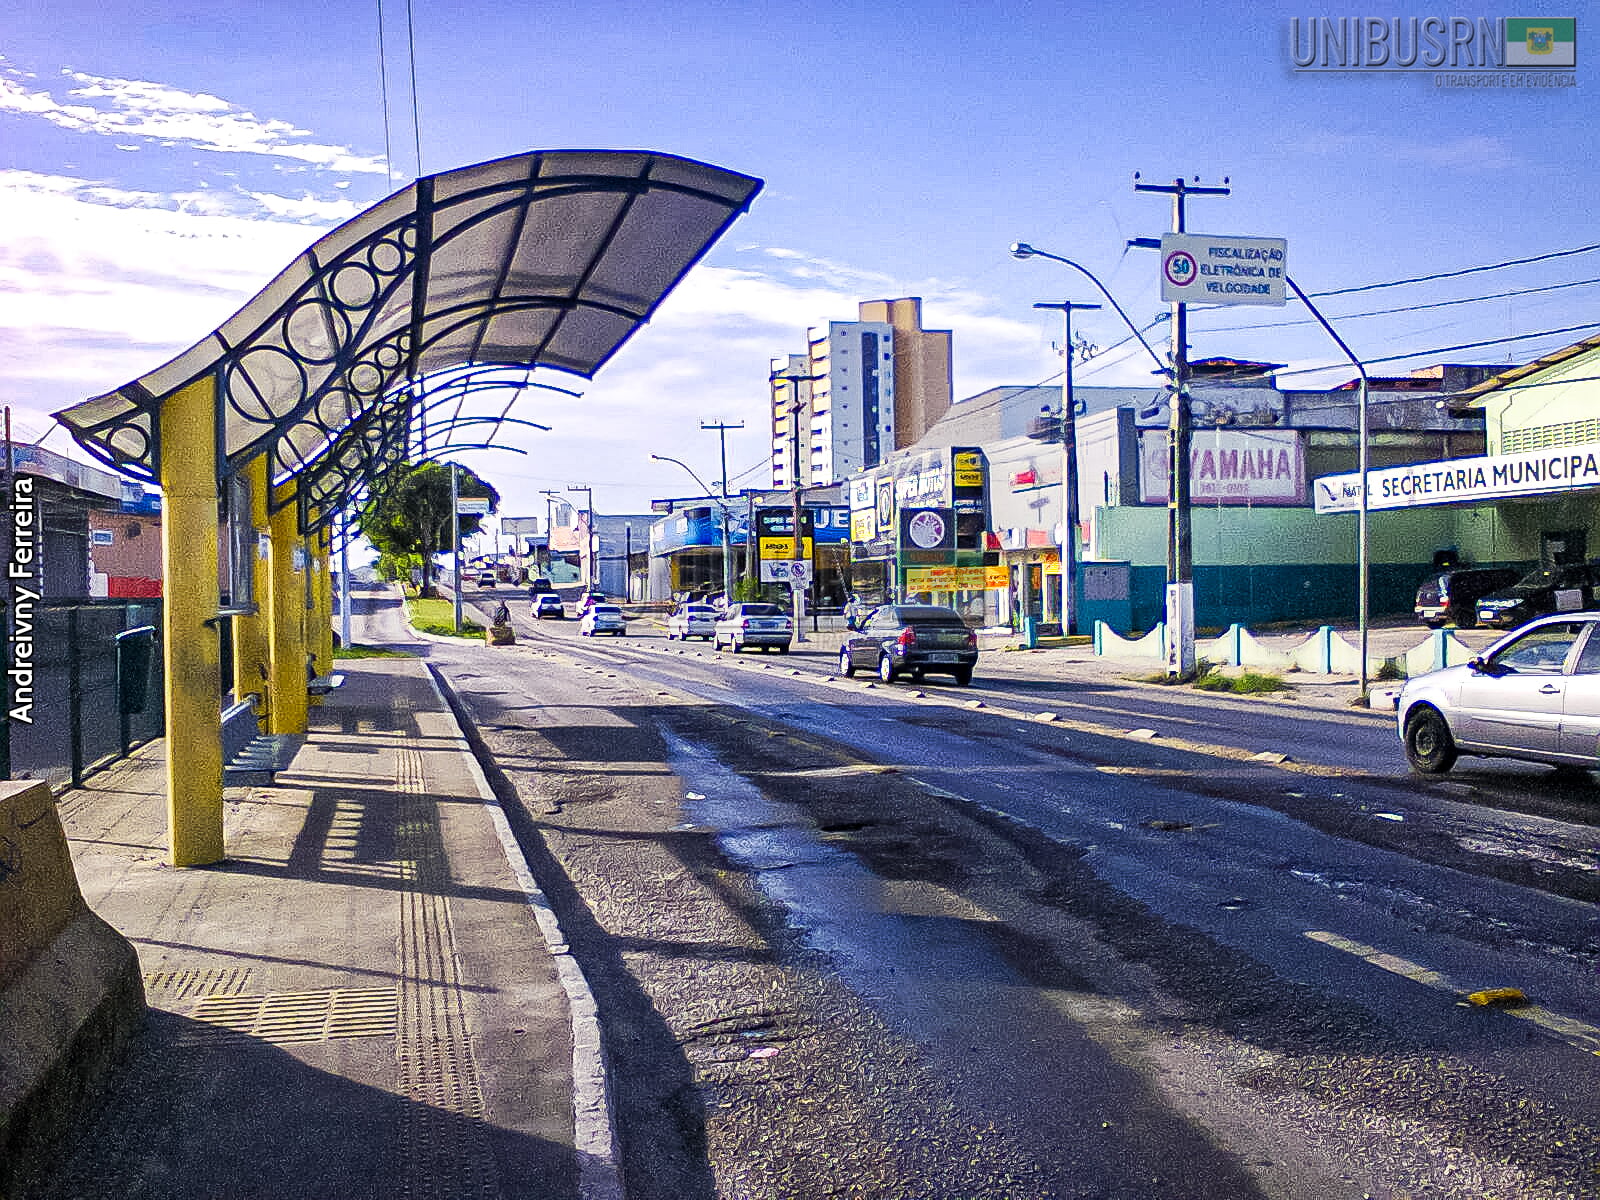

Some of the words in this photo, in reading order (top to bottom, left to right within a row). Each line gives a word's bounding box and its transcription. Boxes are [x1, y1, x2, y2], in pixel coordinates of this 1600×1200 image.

[1172, 258, 1190, 274] 50
[1199, 263, 1266, 278] ELETRÔNICA
[1268, 266, 1282, 279] DE
[1206, 281, 1271, 295] VELOCIDADE
[1382, 467, 1487, 498] SECRETARIA
[1493, 453, 1599, 487] MUNICIPA
